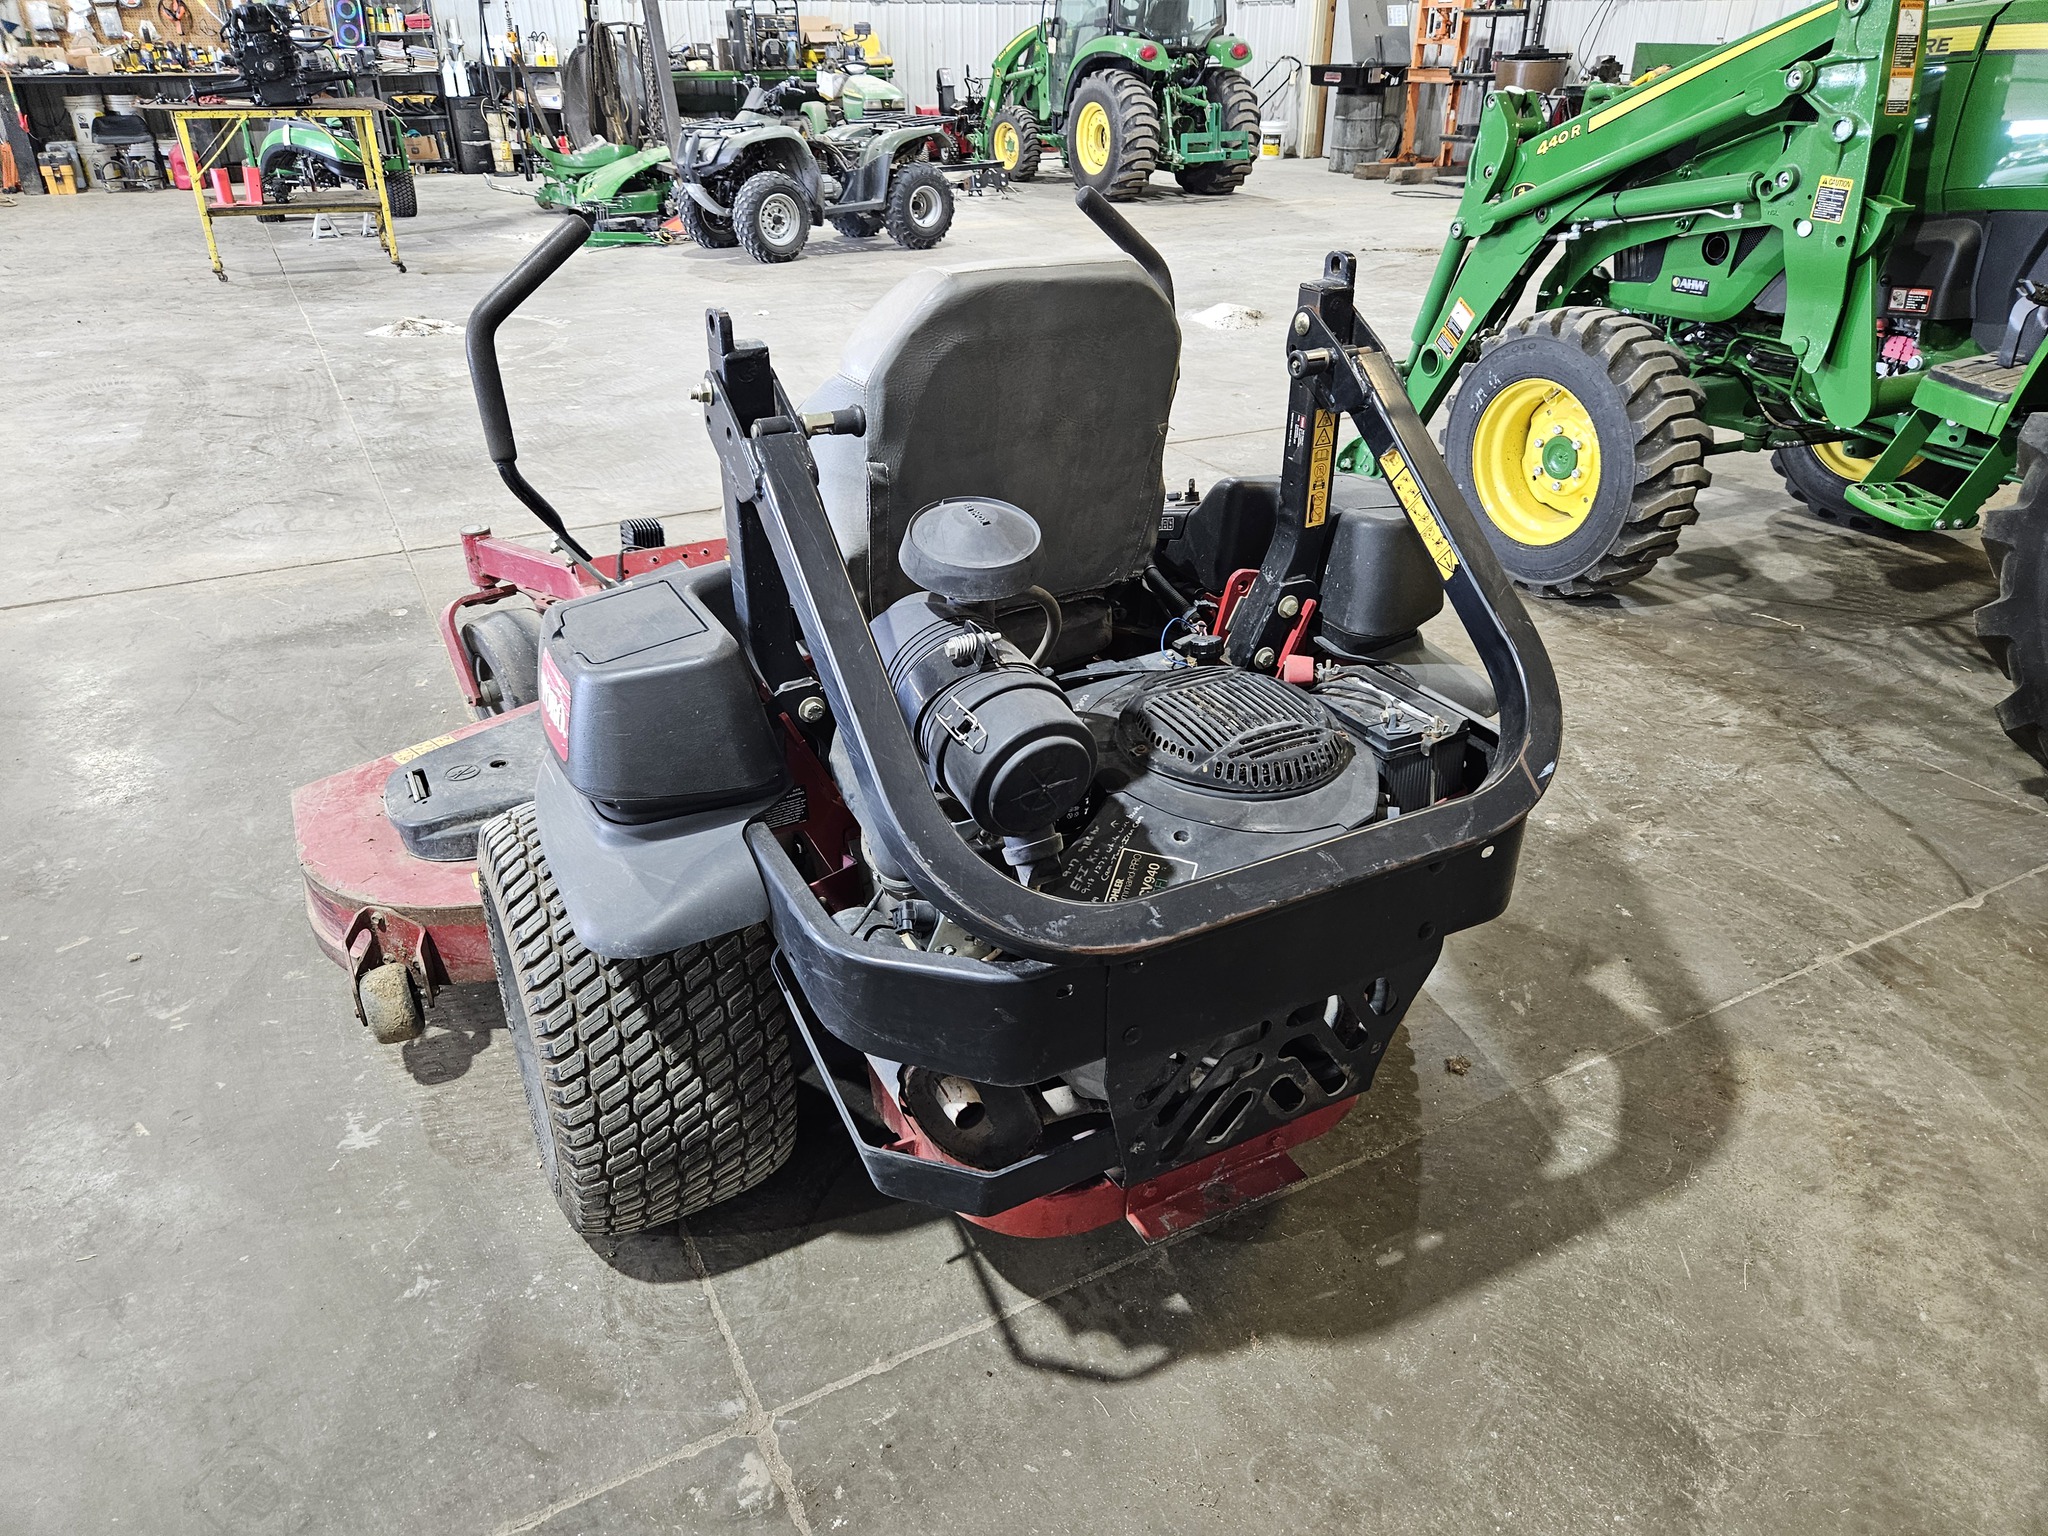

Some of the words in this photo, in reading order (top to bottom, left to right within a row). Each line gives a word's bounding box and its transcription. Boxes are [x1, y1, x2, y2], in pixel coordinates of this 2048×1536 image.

[1926, 37, 1953, 53] RE
[1828, 178, 1851, 188] CAUTION
[1680, 278, 1706, 291] AHW
[1070, 865, 1089, 890] EFI
[1121, 871, 1136, 901] mmand
[1109, 878, 1125, 903] OHLER
